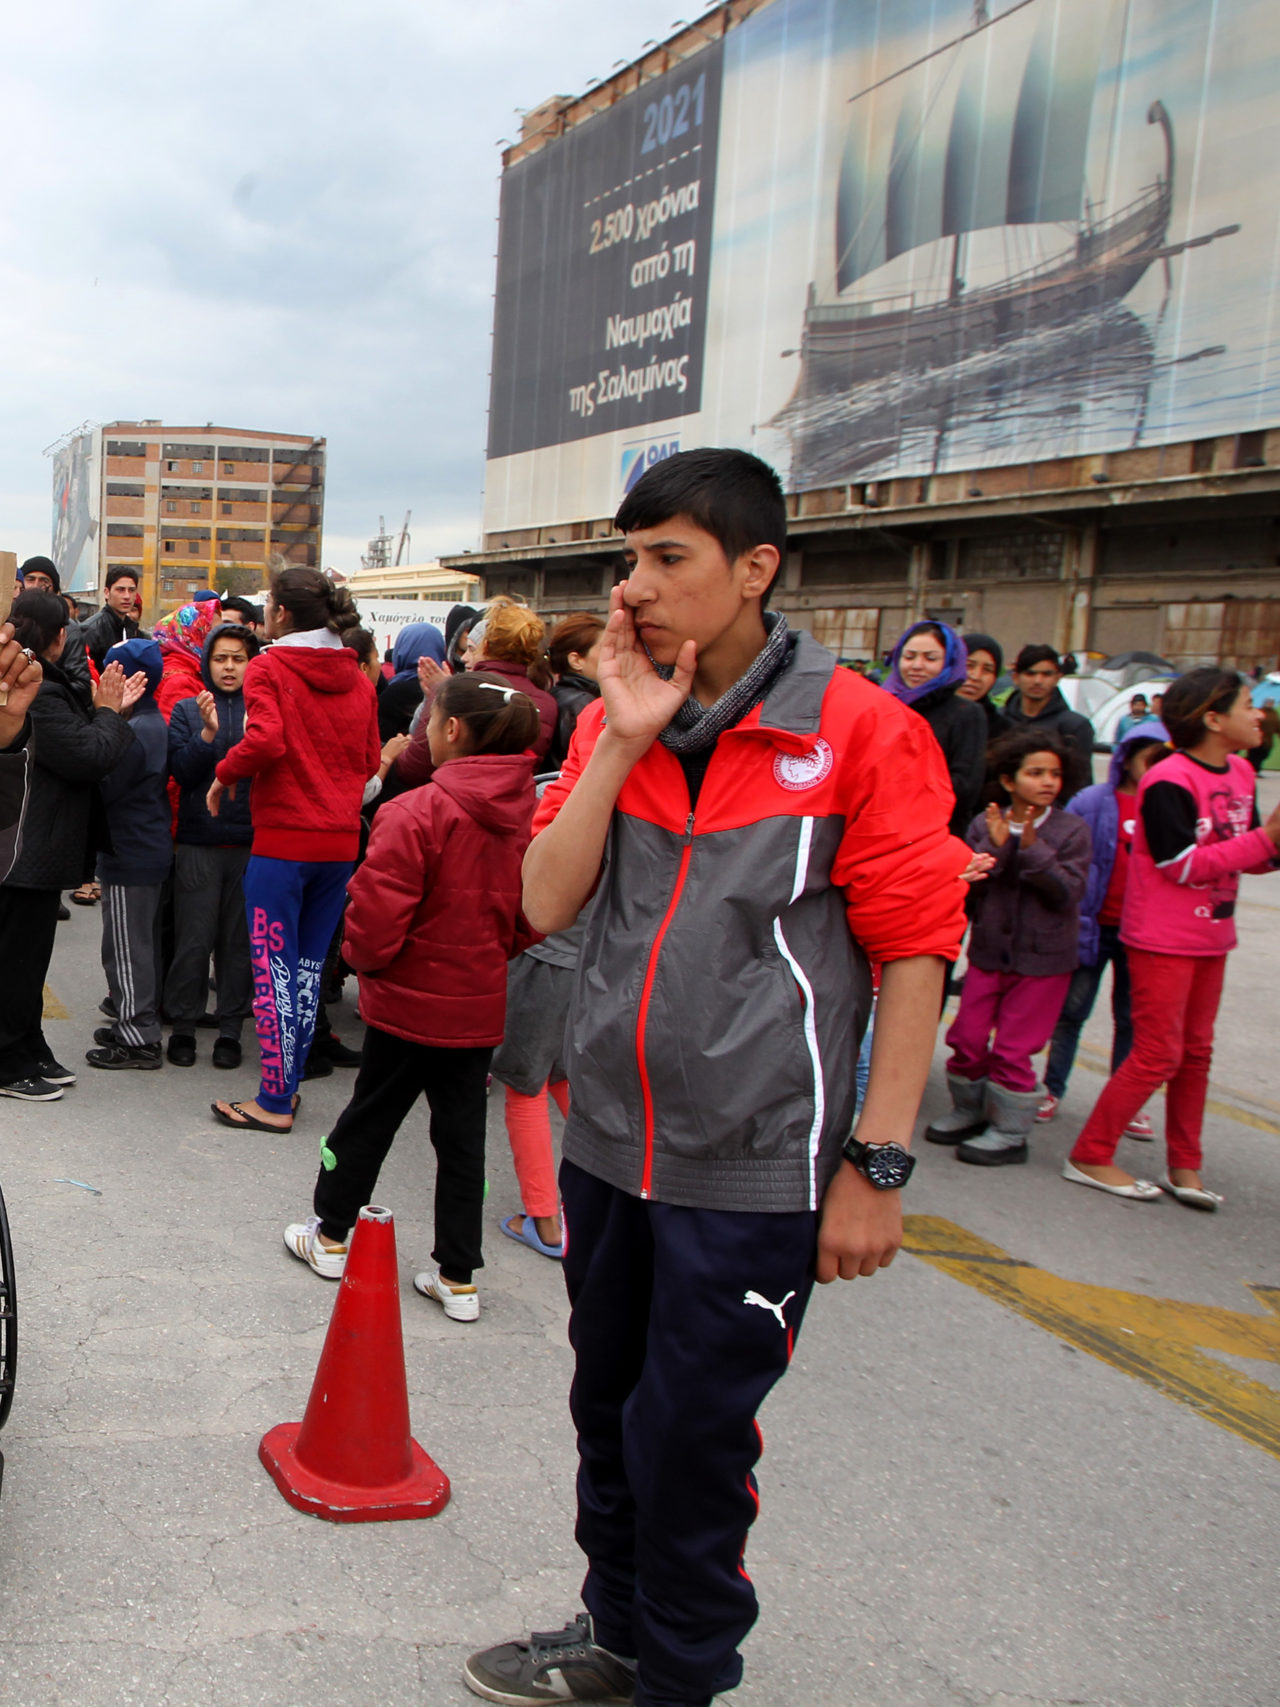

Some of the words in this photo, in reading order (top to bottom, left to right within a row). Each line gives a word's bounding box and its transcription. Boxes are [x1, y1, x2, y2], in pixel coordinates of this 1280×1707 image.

[640, 73, 706, 155] 2021
[589, 203, 634, 255] 2.500
[634, 179, 701, 243] χρόνια
[630, 240, 670, 288] από
[673, 239, 696, 277] τη
[605, 291, 693, 350] Ναυμαχία
[569, 382, 596, 418] της
[596, 354, 690, 405] Σαλαμίνας
[369, 611, 425, 625] Χαμόγελο
